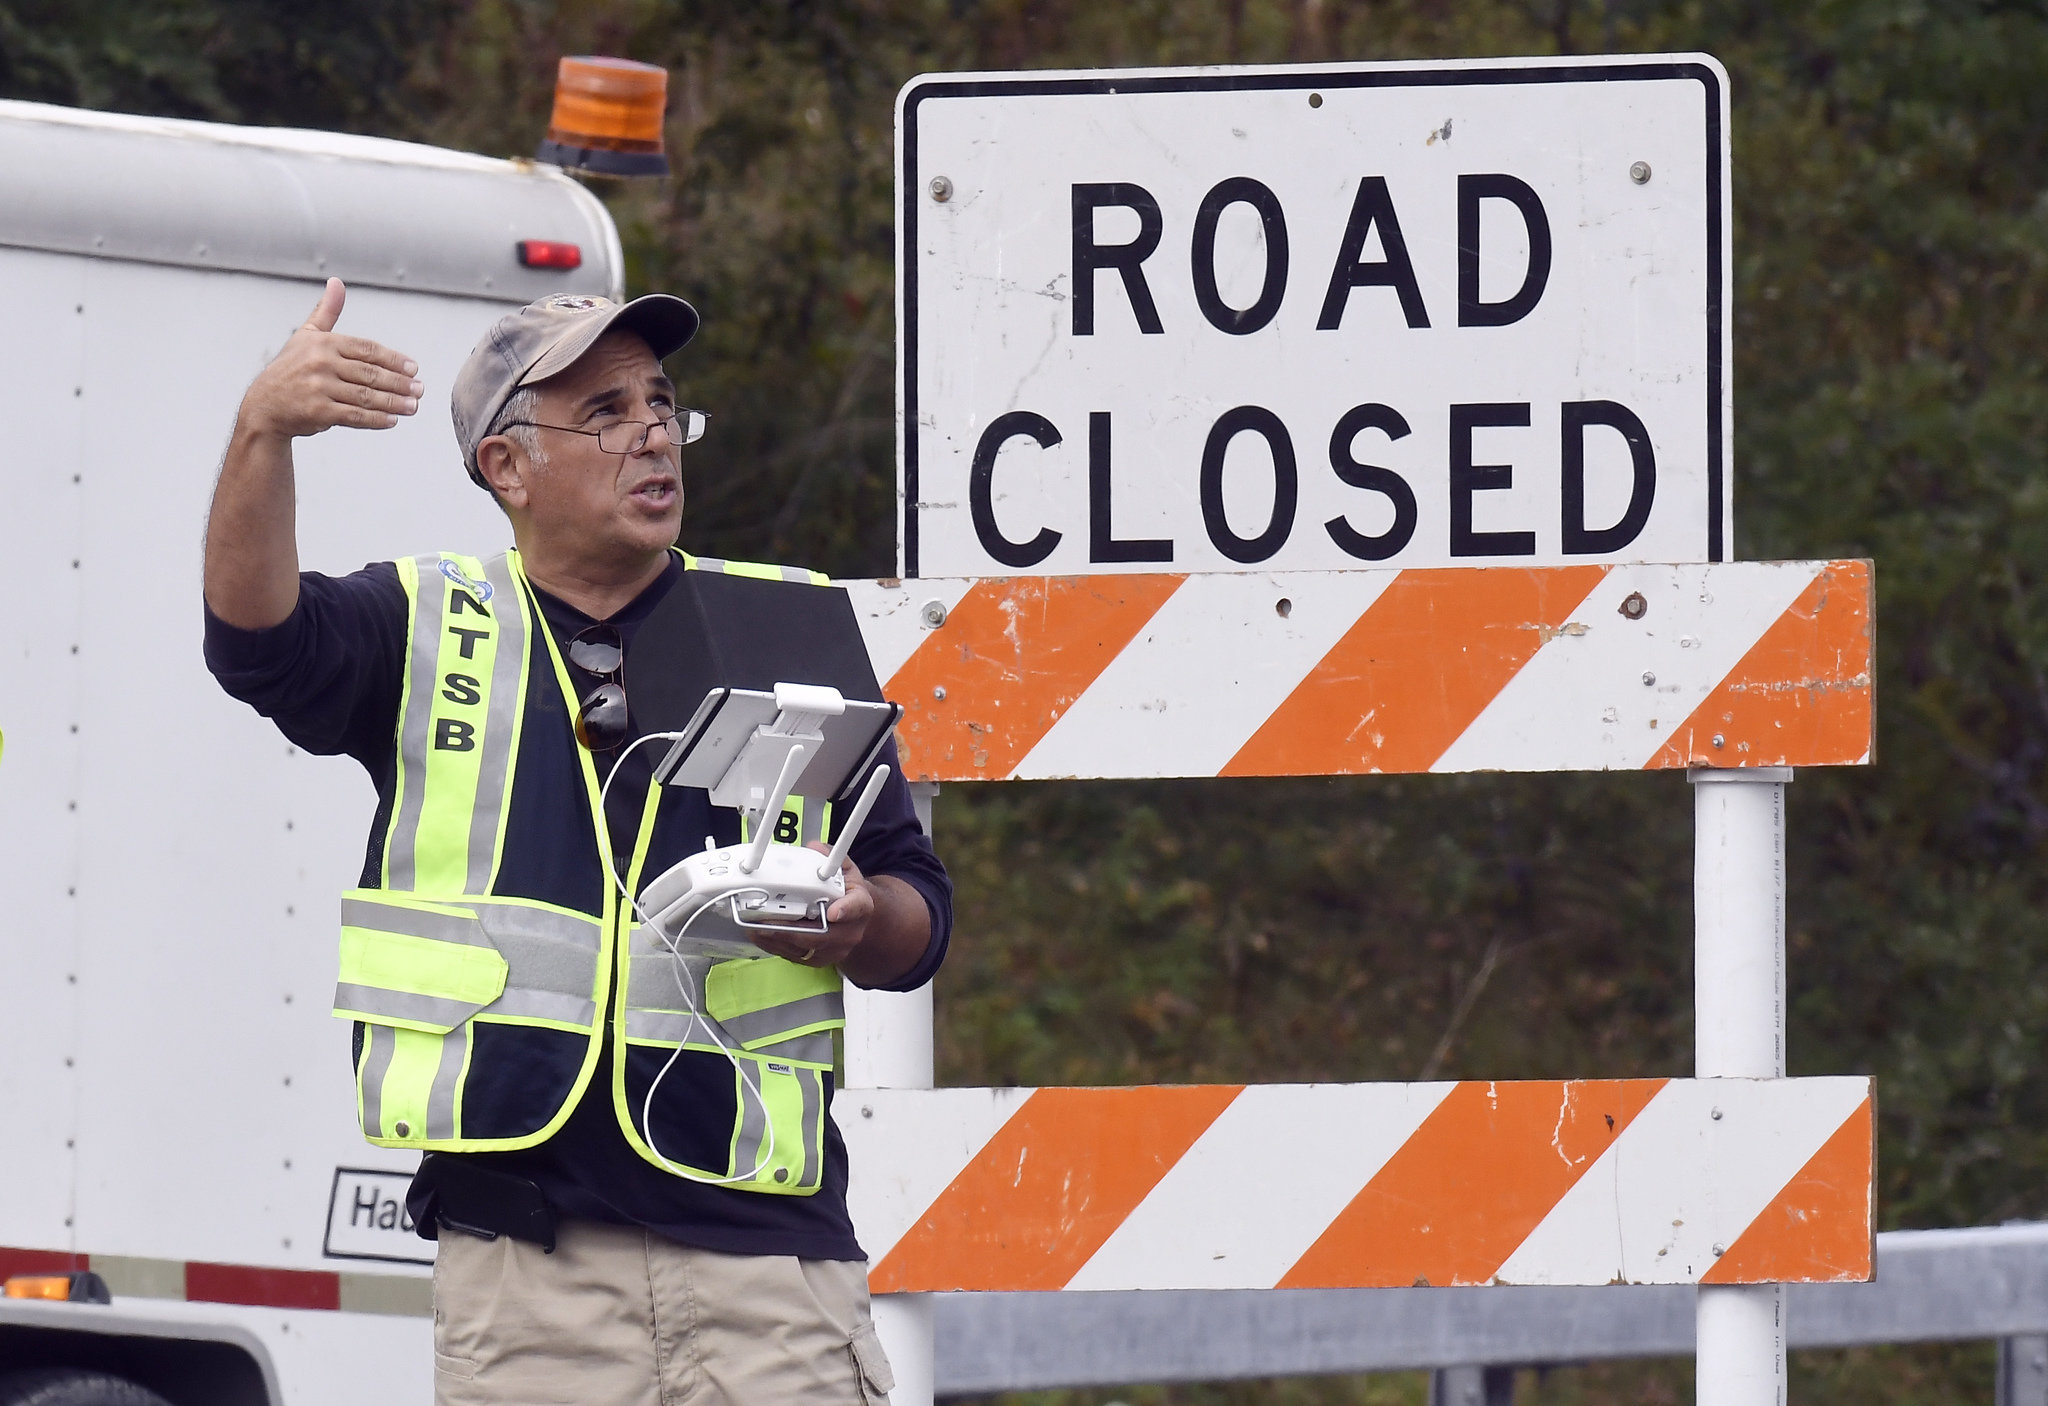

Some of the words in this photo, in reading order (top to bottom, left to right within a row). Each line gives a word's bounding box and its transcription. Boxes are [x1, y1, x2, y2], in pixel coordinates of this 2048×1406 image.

[1071, 173, 1552, 336] ROAD
[969, 399, 1657, 568] CLOSED
[434, 588, 491, 752] NTSB
